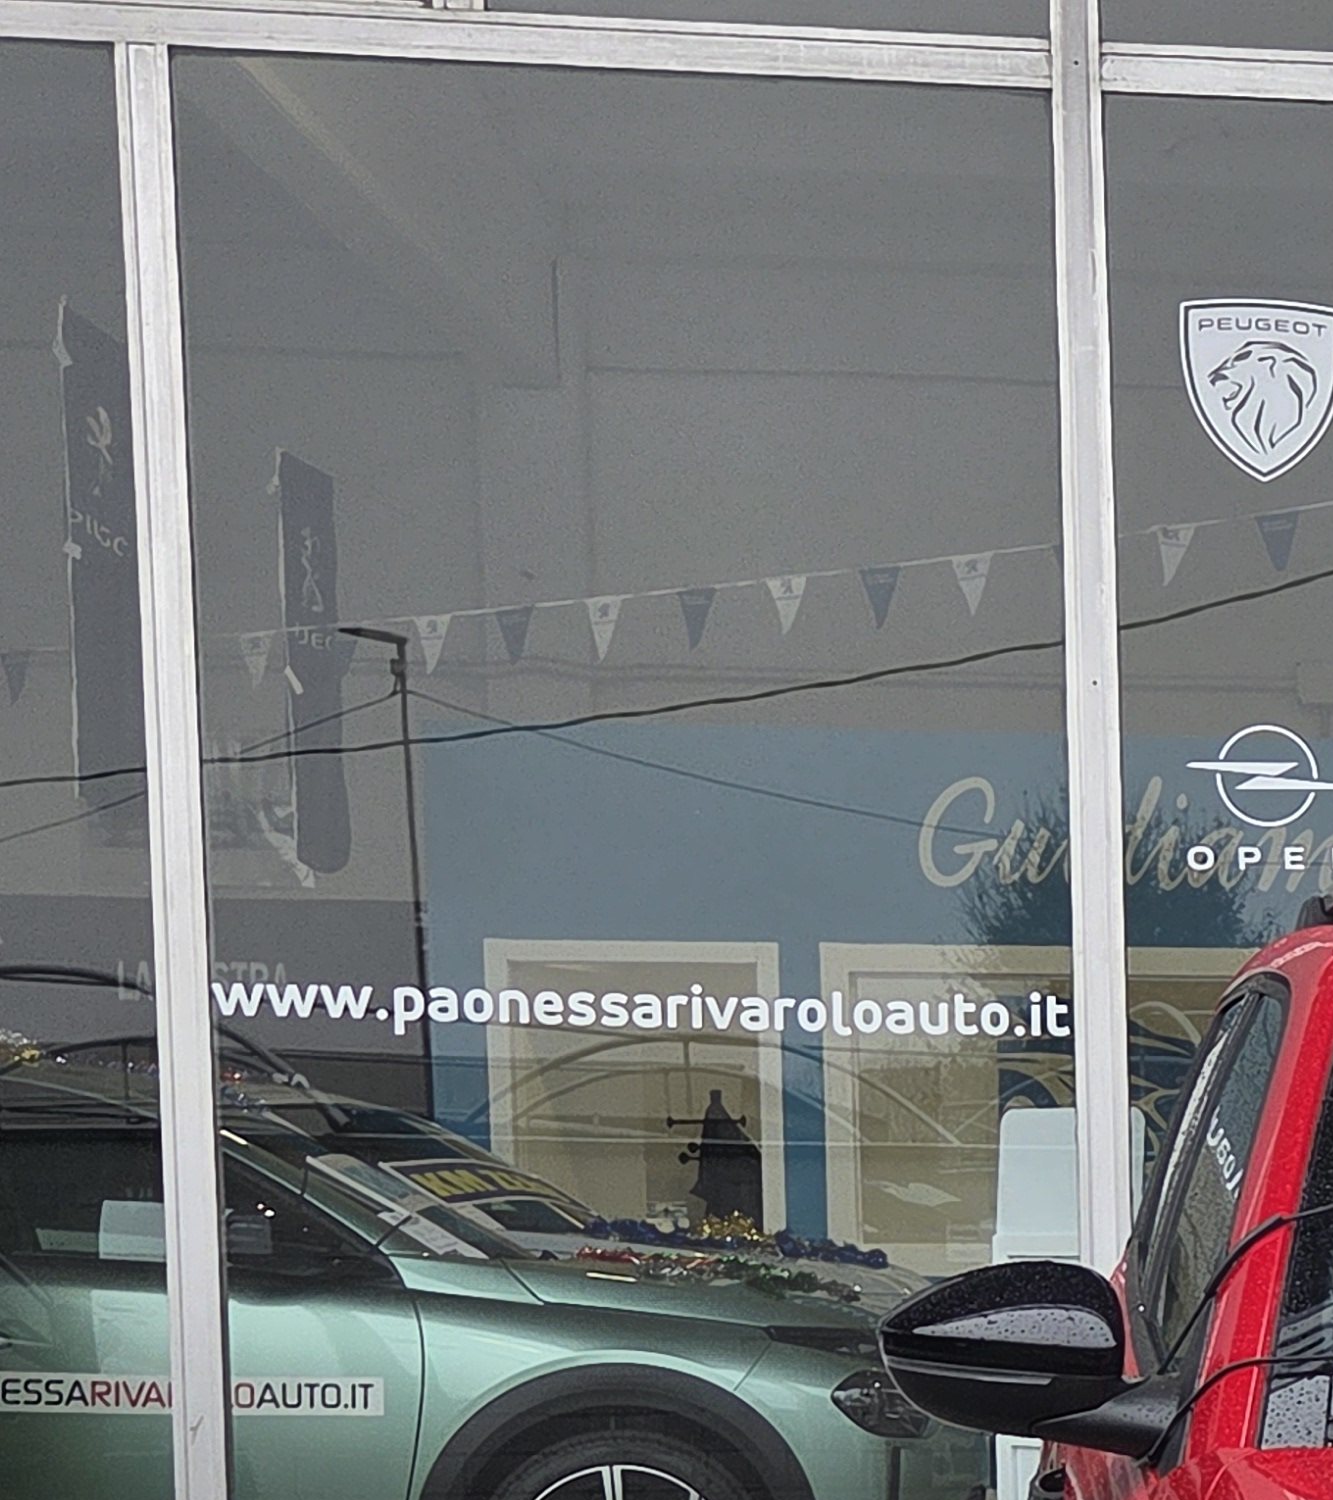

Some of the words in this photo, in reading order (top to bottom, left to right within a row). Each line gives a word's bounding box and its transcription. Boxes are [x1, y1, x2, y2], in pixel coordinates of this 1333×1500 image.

[1198, 317, 1328, 336] PEUGEOT
[212, 980, 1072, 1038] www.paonessarivaroloauto.it
[0, 1378, 375, 1410] ESSARIVAOAUTO.IT
